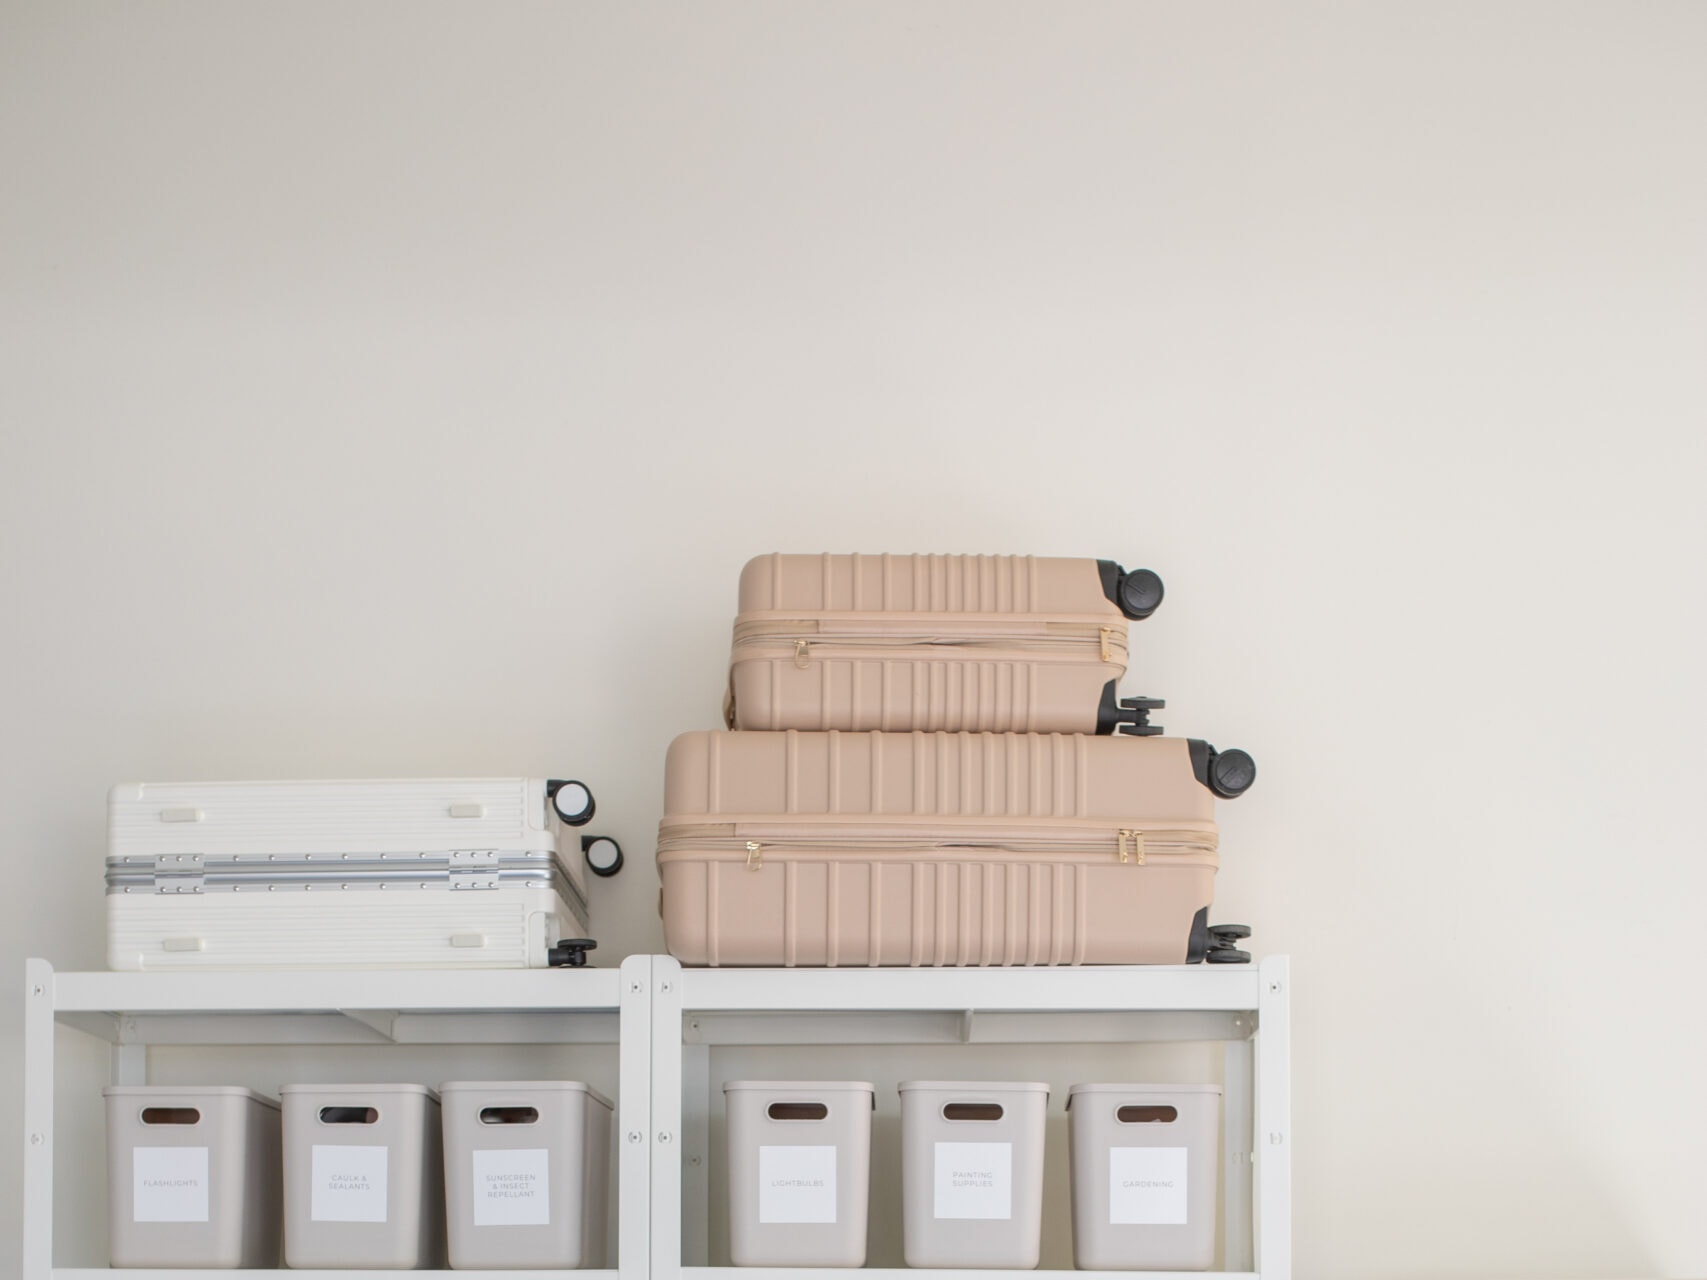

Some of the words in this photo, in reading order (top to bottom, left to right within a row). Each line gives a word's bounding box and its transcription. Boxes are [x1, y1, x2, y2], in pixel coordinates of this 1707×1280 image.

[331, 1174, 360, 1182] CAULK
[486, 1174, 536, 1182] SUNSCREEN
[143, 1179, 199, 1188] FLASHLIGHTS
[328, 1183, 370, 1191] SEALANTS
[771, 1179, 825, 1187] LIGHTBULBS
[1122, 1180, 1174, 1188] GARDENING
[487, 1191, 536, 1199] REPELLANT
